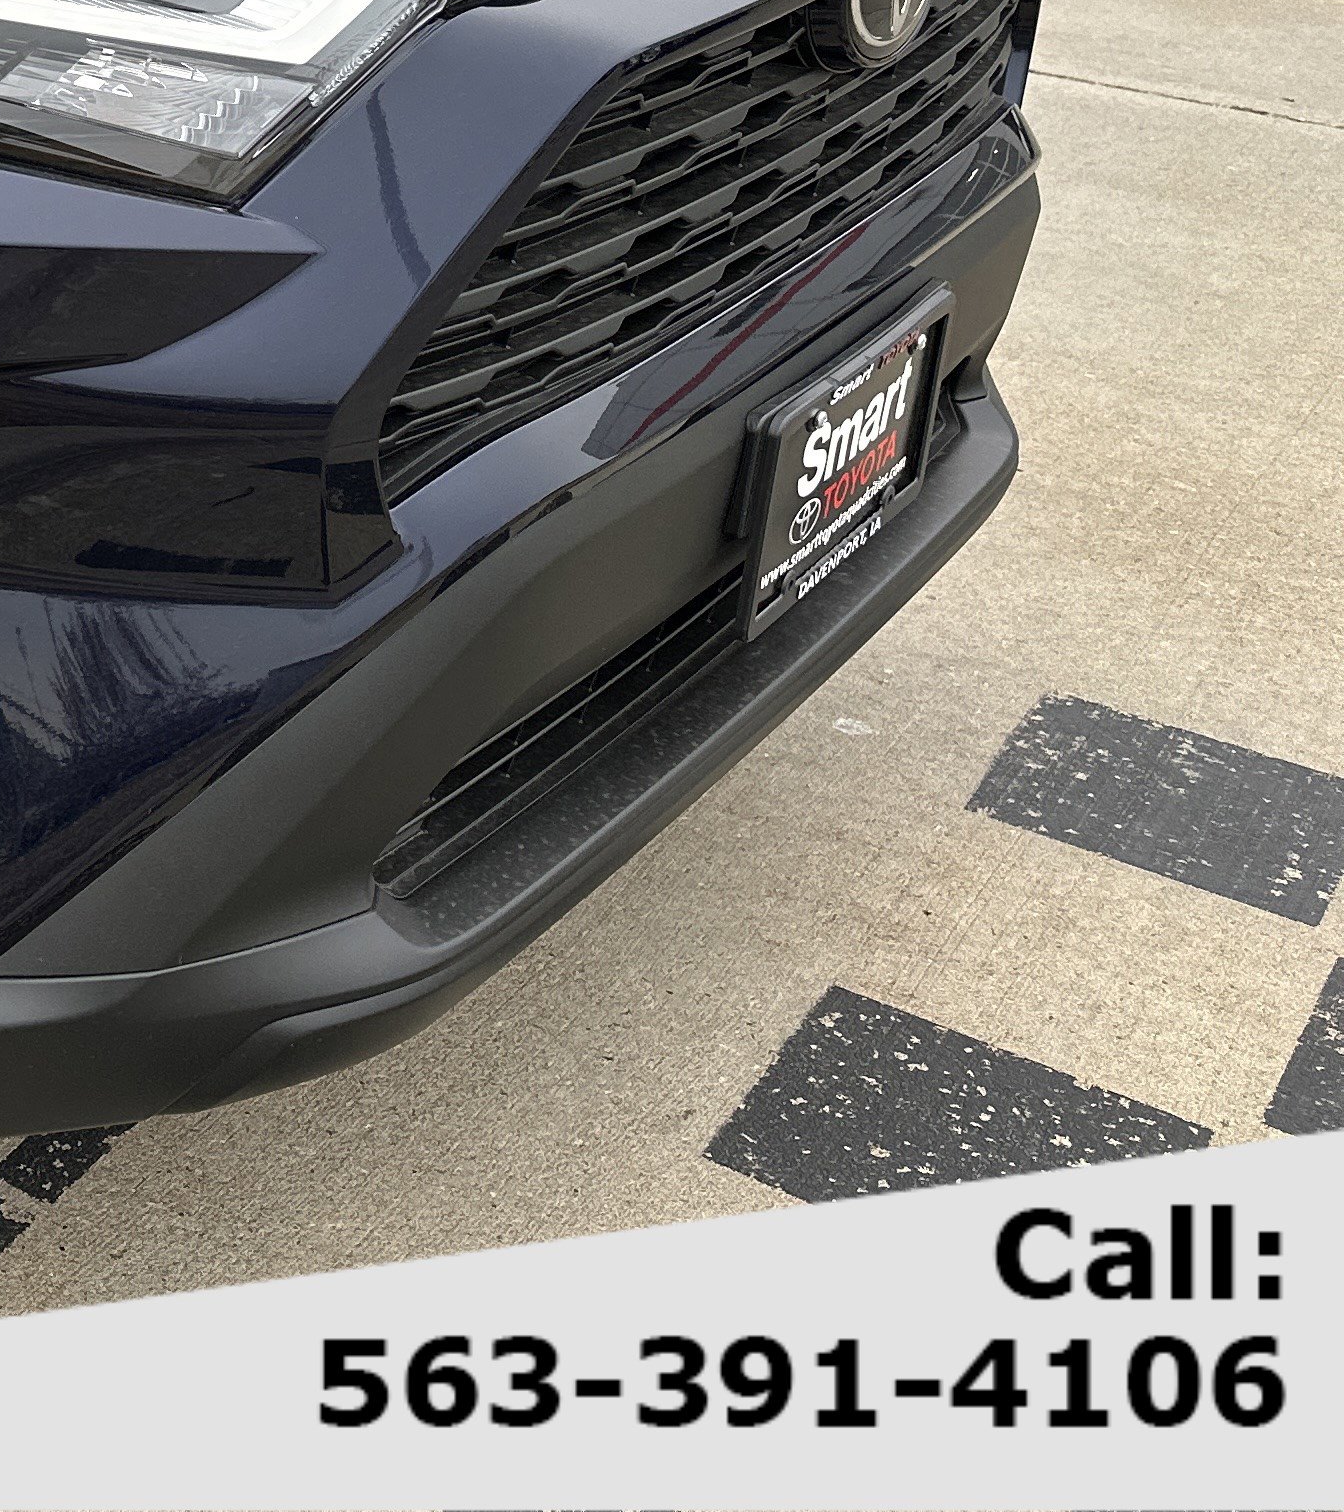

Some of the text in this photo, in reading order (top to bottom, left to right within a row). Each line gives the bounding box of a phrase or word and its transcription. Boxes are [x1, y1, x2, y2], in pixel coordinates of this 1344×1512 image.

[798, 357, 913, 497] Smart
[823, 430, 898, 519] TOYOTA
[869, 516, 882, 537] IA
